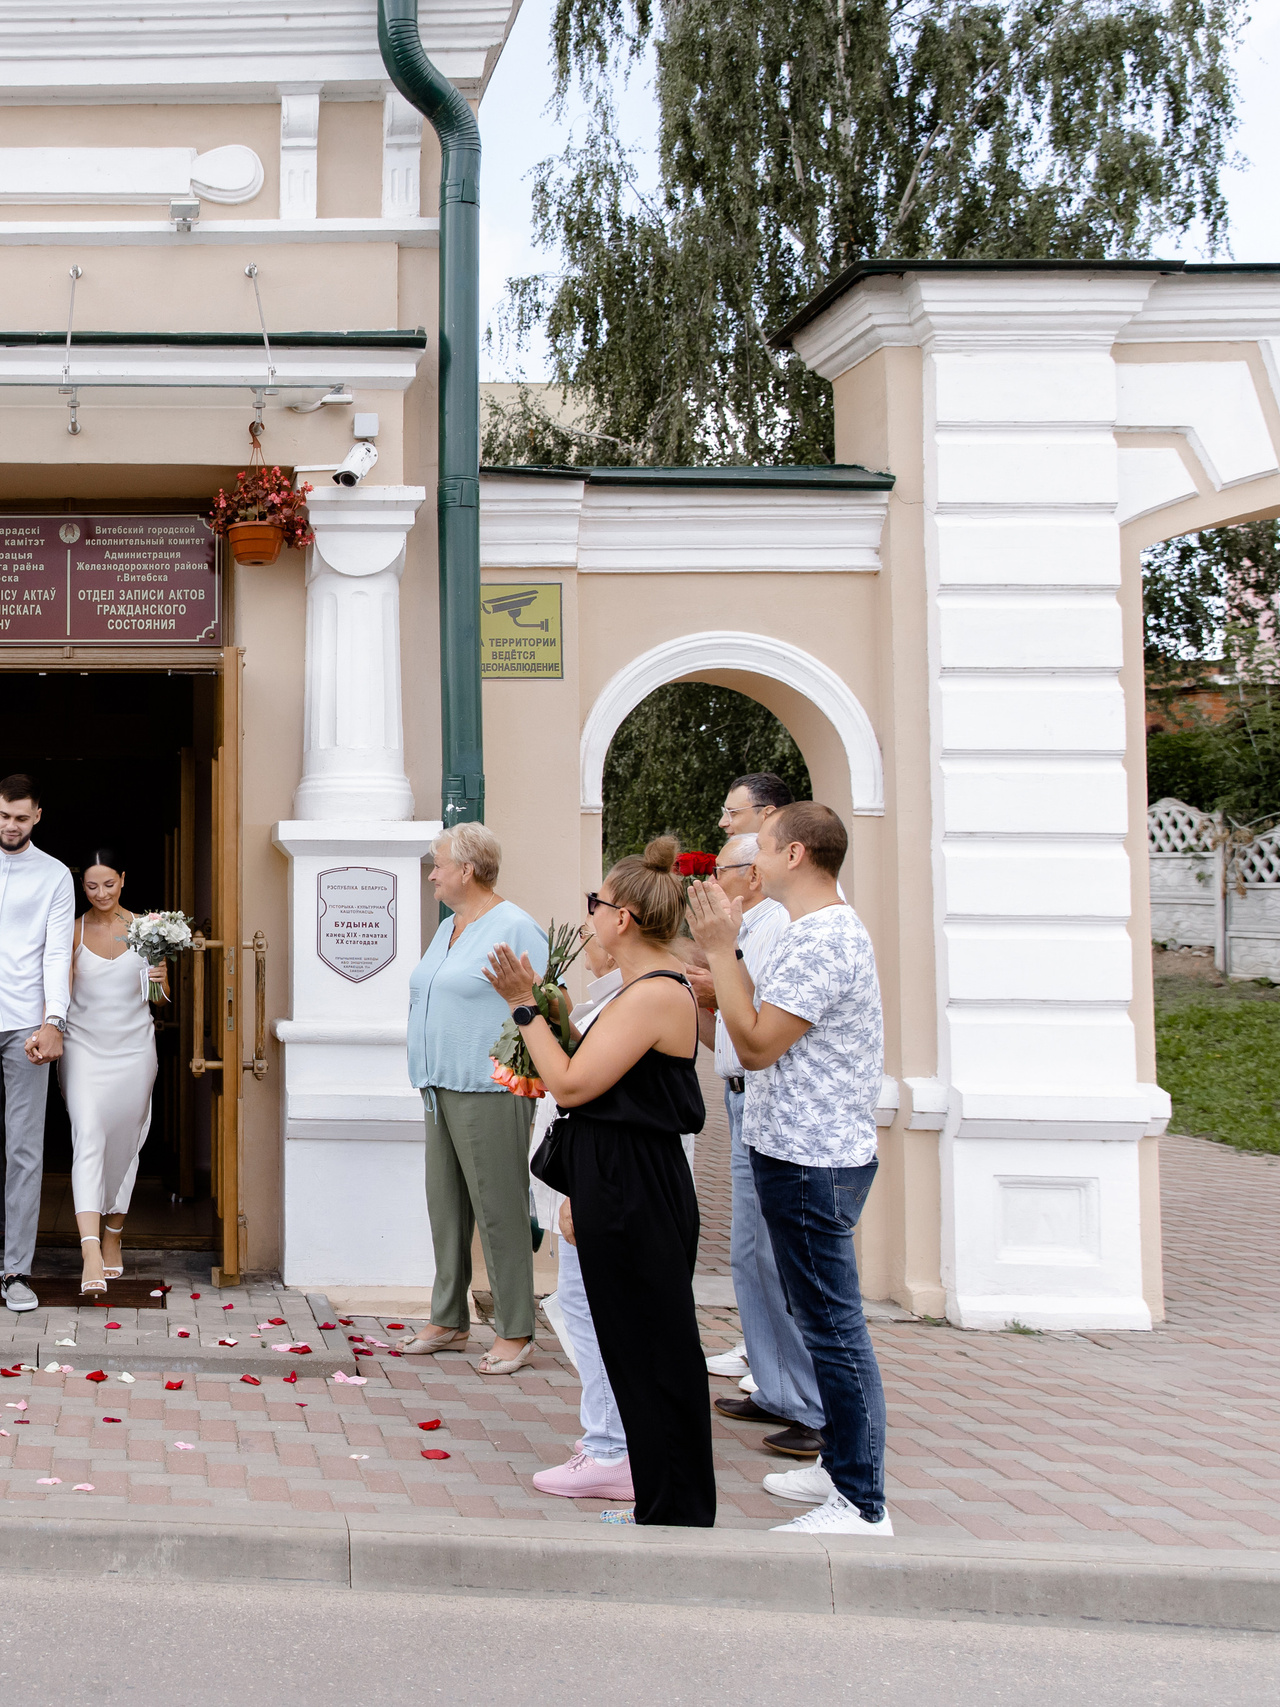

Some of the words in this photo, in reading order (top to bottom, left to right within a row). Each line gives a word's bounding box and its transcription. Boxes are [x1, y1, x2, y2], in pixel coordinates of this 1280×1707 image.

[95, 526, 144, 534] Витебский
[148, 525, 195, 535] городской
[85, 537, 164, 546] исполнительный
[104, 551, 181, 560] Администрация
[13, 562, 45, 572] раёна
[76, 562, 171, 572] Железнодорожного
[175, 561, 209, 572] района
[117, 573, 168, 582] г.Витебска
[23, 587, 56, 601] АКТАЎ
[78, 590, 114, 602] ОТДЕЛ
[119, 590, 164, 600] ЗАПИСИ
[169, 589, 205, 600] АКТОВ
[97, 604, 186, 617] ГРАЖДАНСКОГО
[108, 619, 175, 630] СОСТОЯНИЯ
[489, 638, 556, 647] ТЕРРИТОРИИ
[492, 649, 536, 661] ВЕДЁТСЯ
[481, 663, 560, 673] ДЕОНАБЛЮДЕНИЕ
